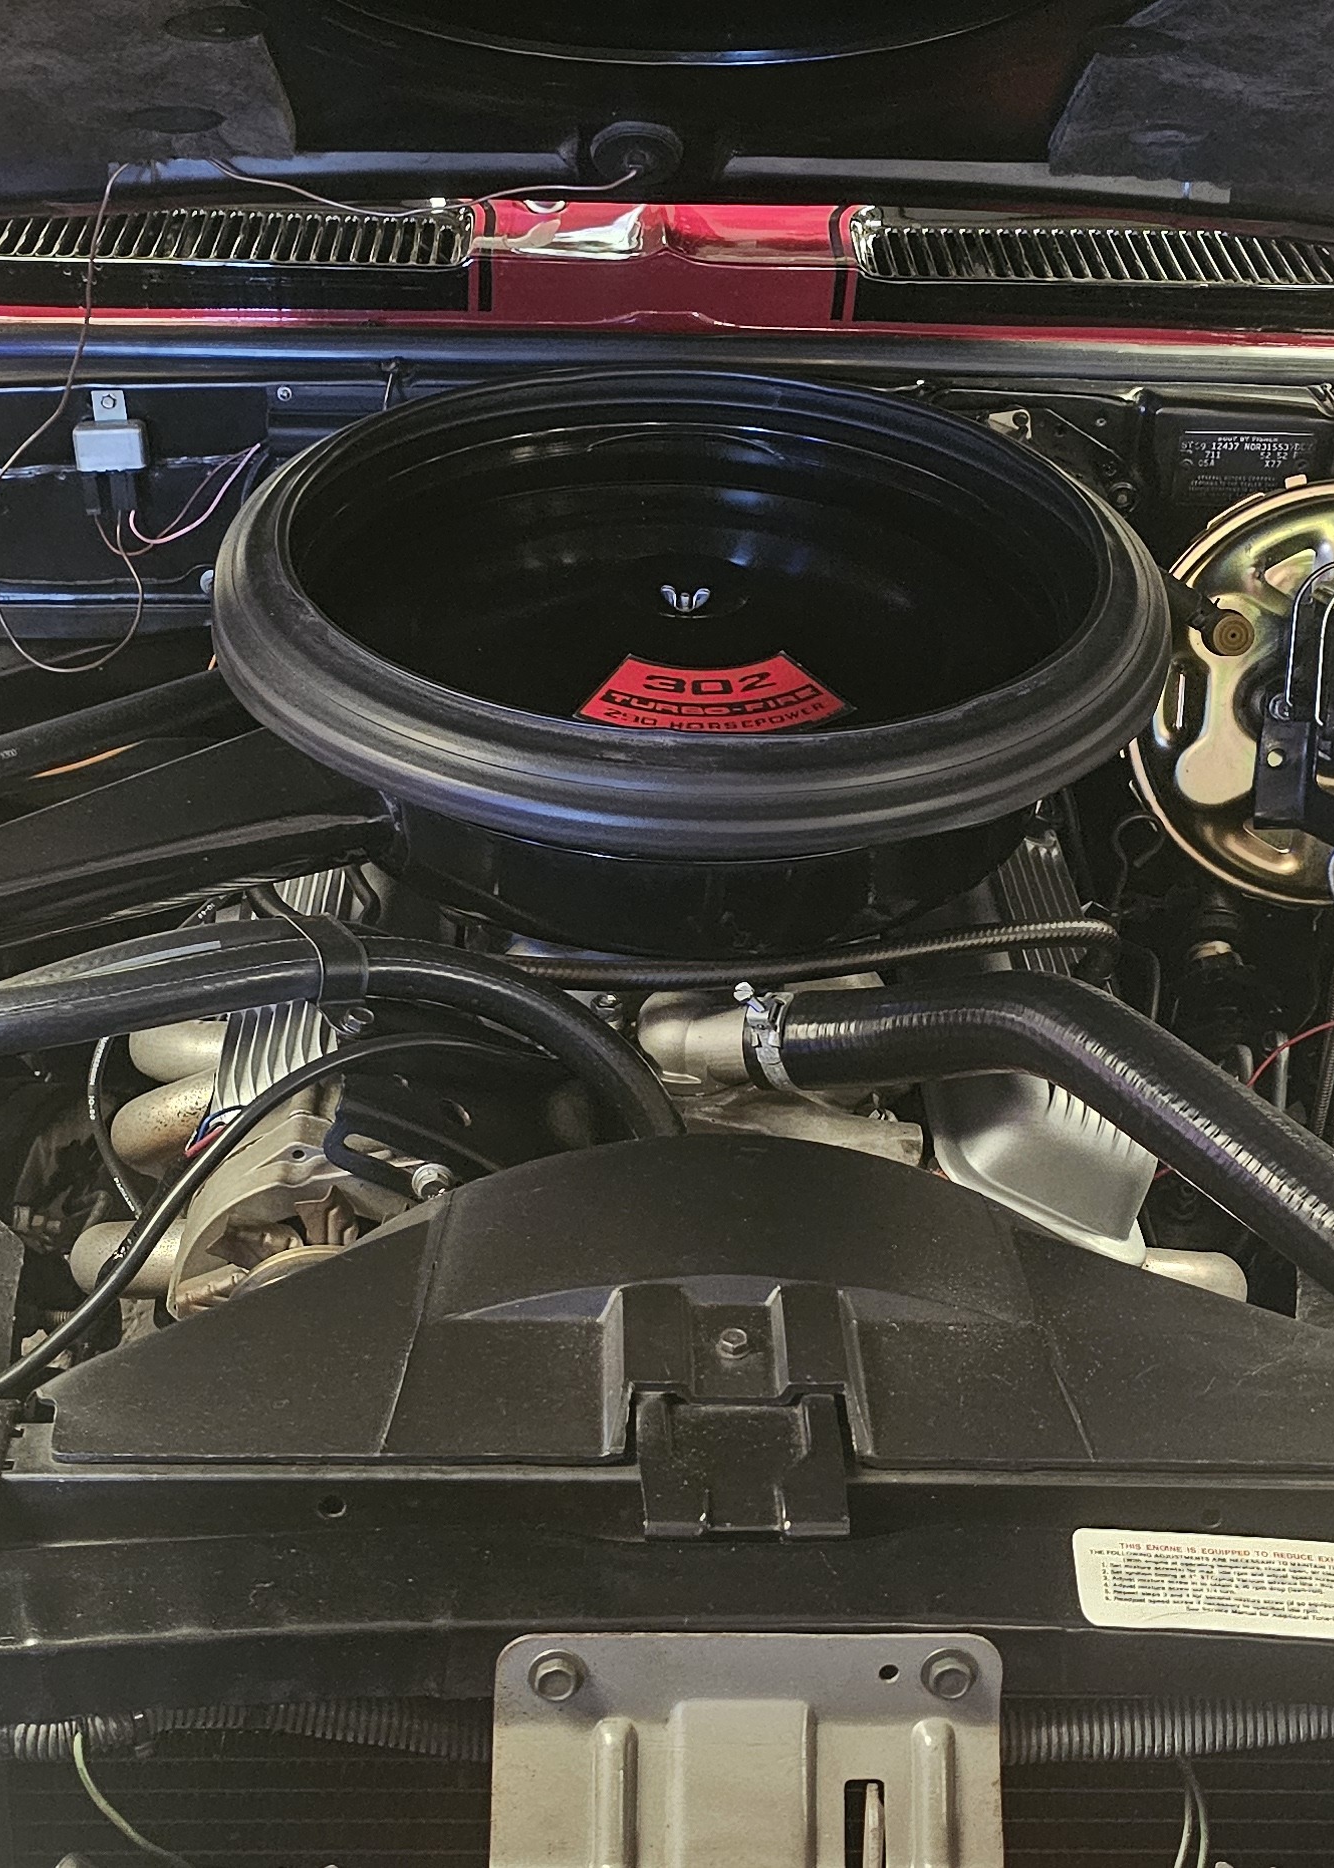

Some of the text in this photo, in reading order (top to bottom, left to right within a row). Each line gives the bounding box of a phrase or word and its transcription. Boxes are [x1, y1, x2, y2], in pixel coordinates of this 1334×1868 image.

[643, 672, 776, 695] 302
[606, 687, 821, 716] TURBO-FIRE
[670, 703, 825, 730] HORSEPOWER
[1201, 1548, 1250, 1557] EQUIPPED
[1273, 1552, 1313, 1561] REDUCE
